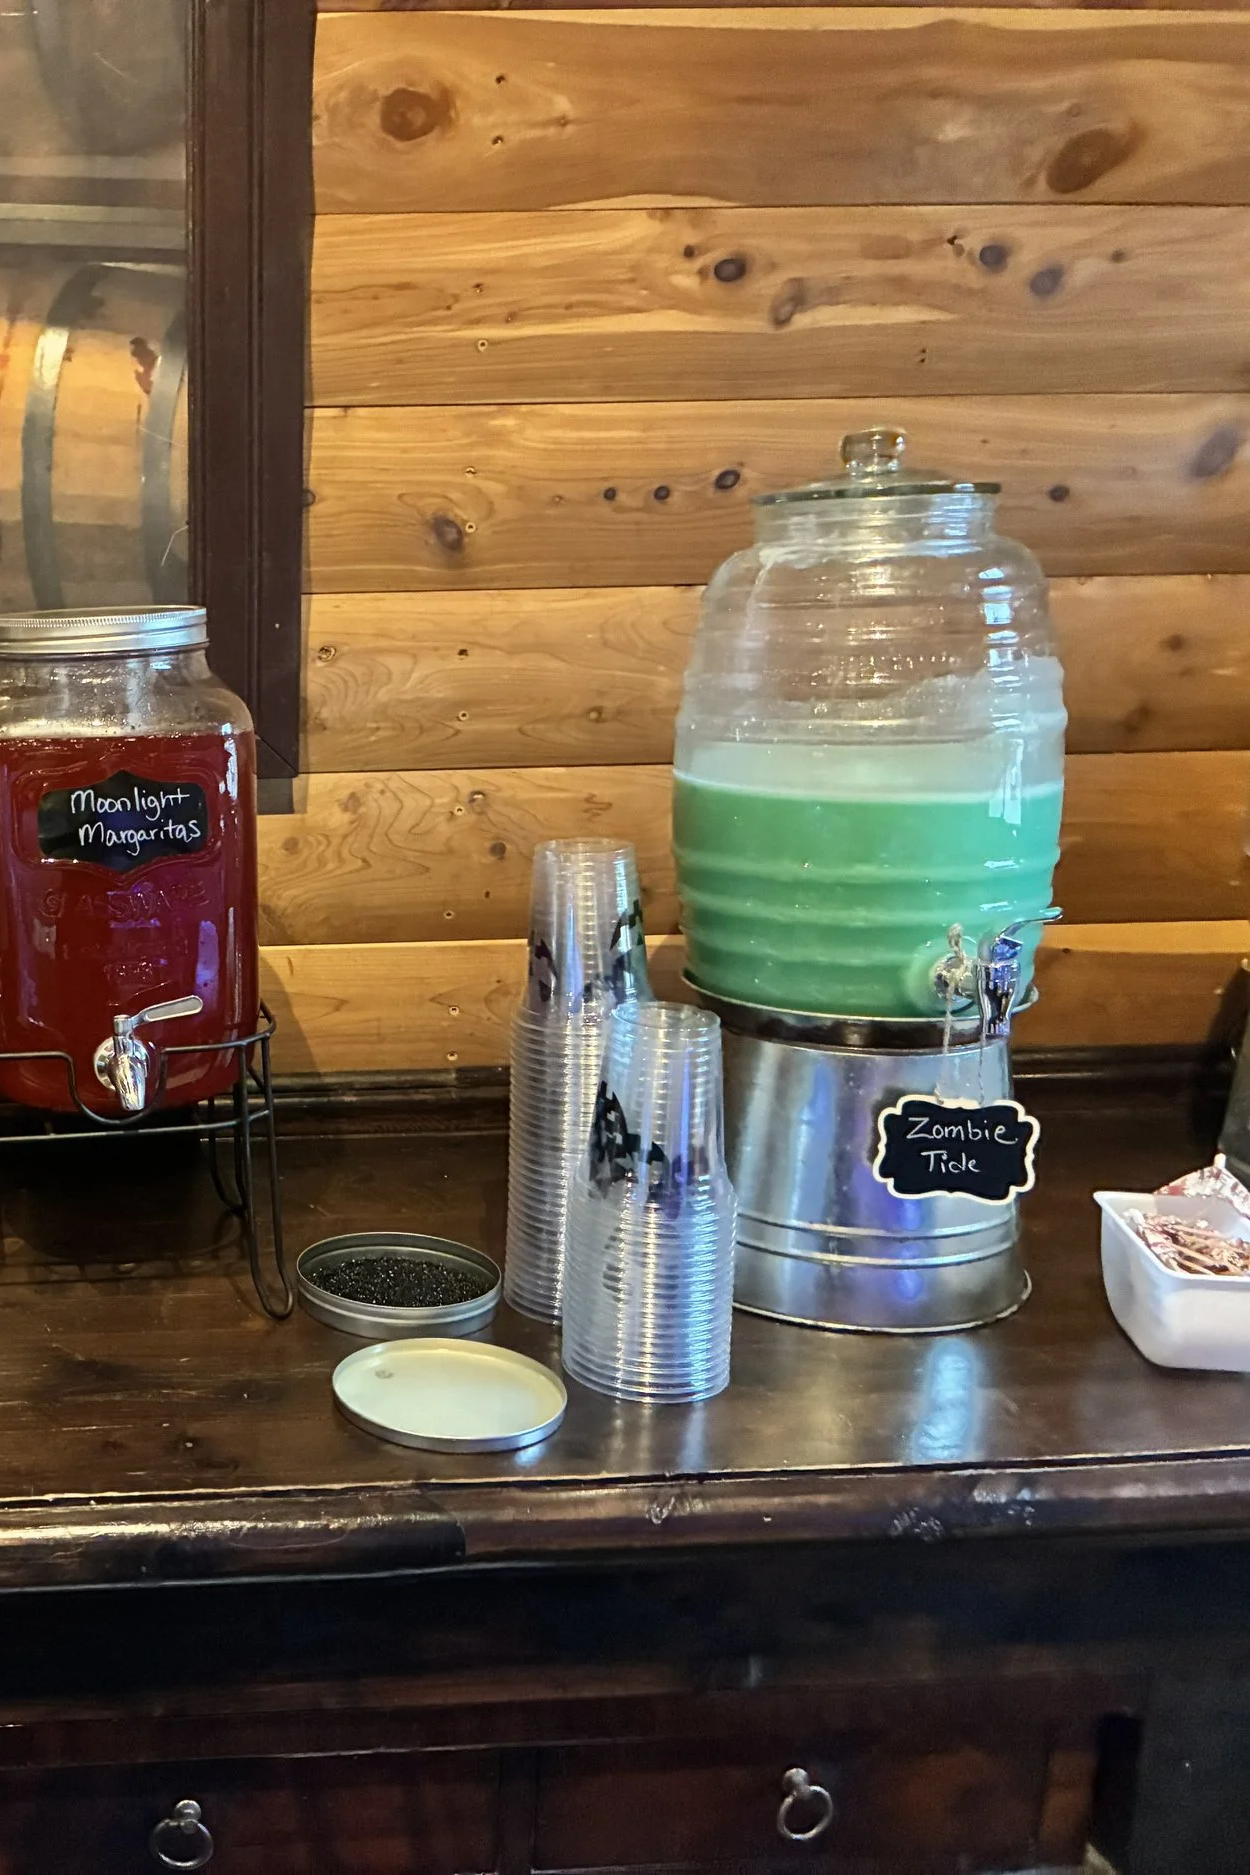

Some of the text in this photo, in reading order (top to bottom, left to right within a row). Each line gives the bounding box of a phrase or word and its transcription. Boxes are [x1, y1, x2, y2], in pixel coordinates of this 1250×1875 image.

[70, 786, 190, 821] Moonlight
[78, 819, 201, 856] Margaritas
[906, 1117, 1019, 1145] Zombie
[920, 1150, 981, 1174] Tide
